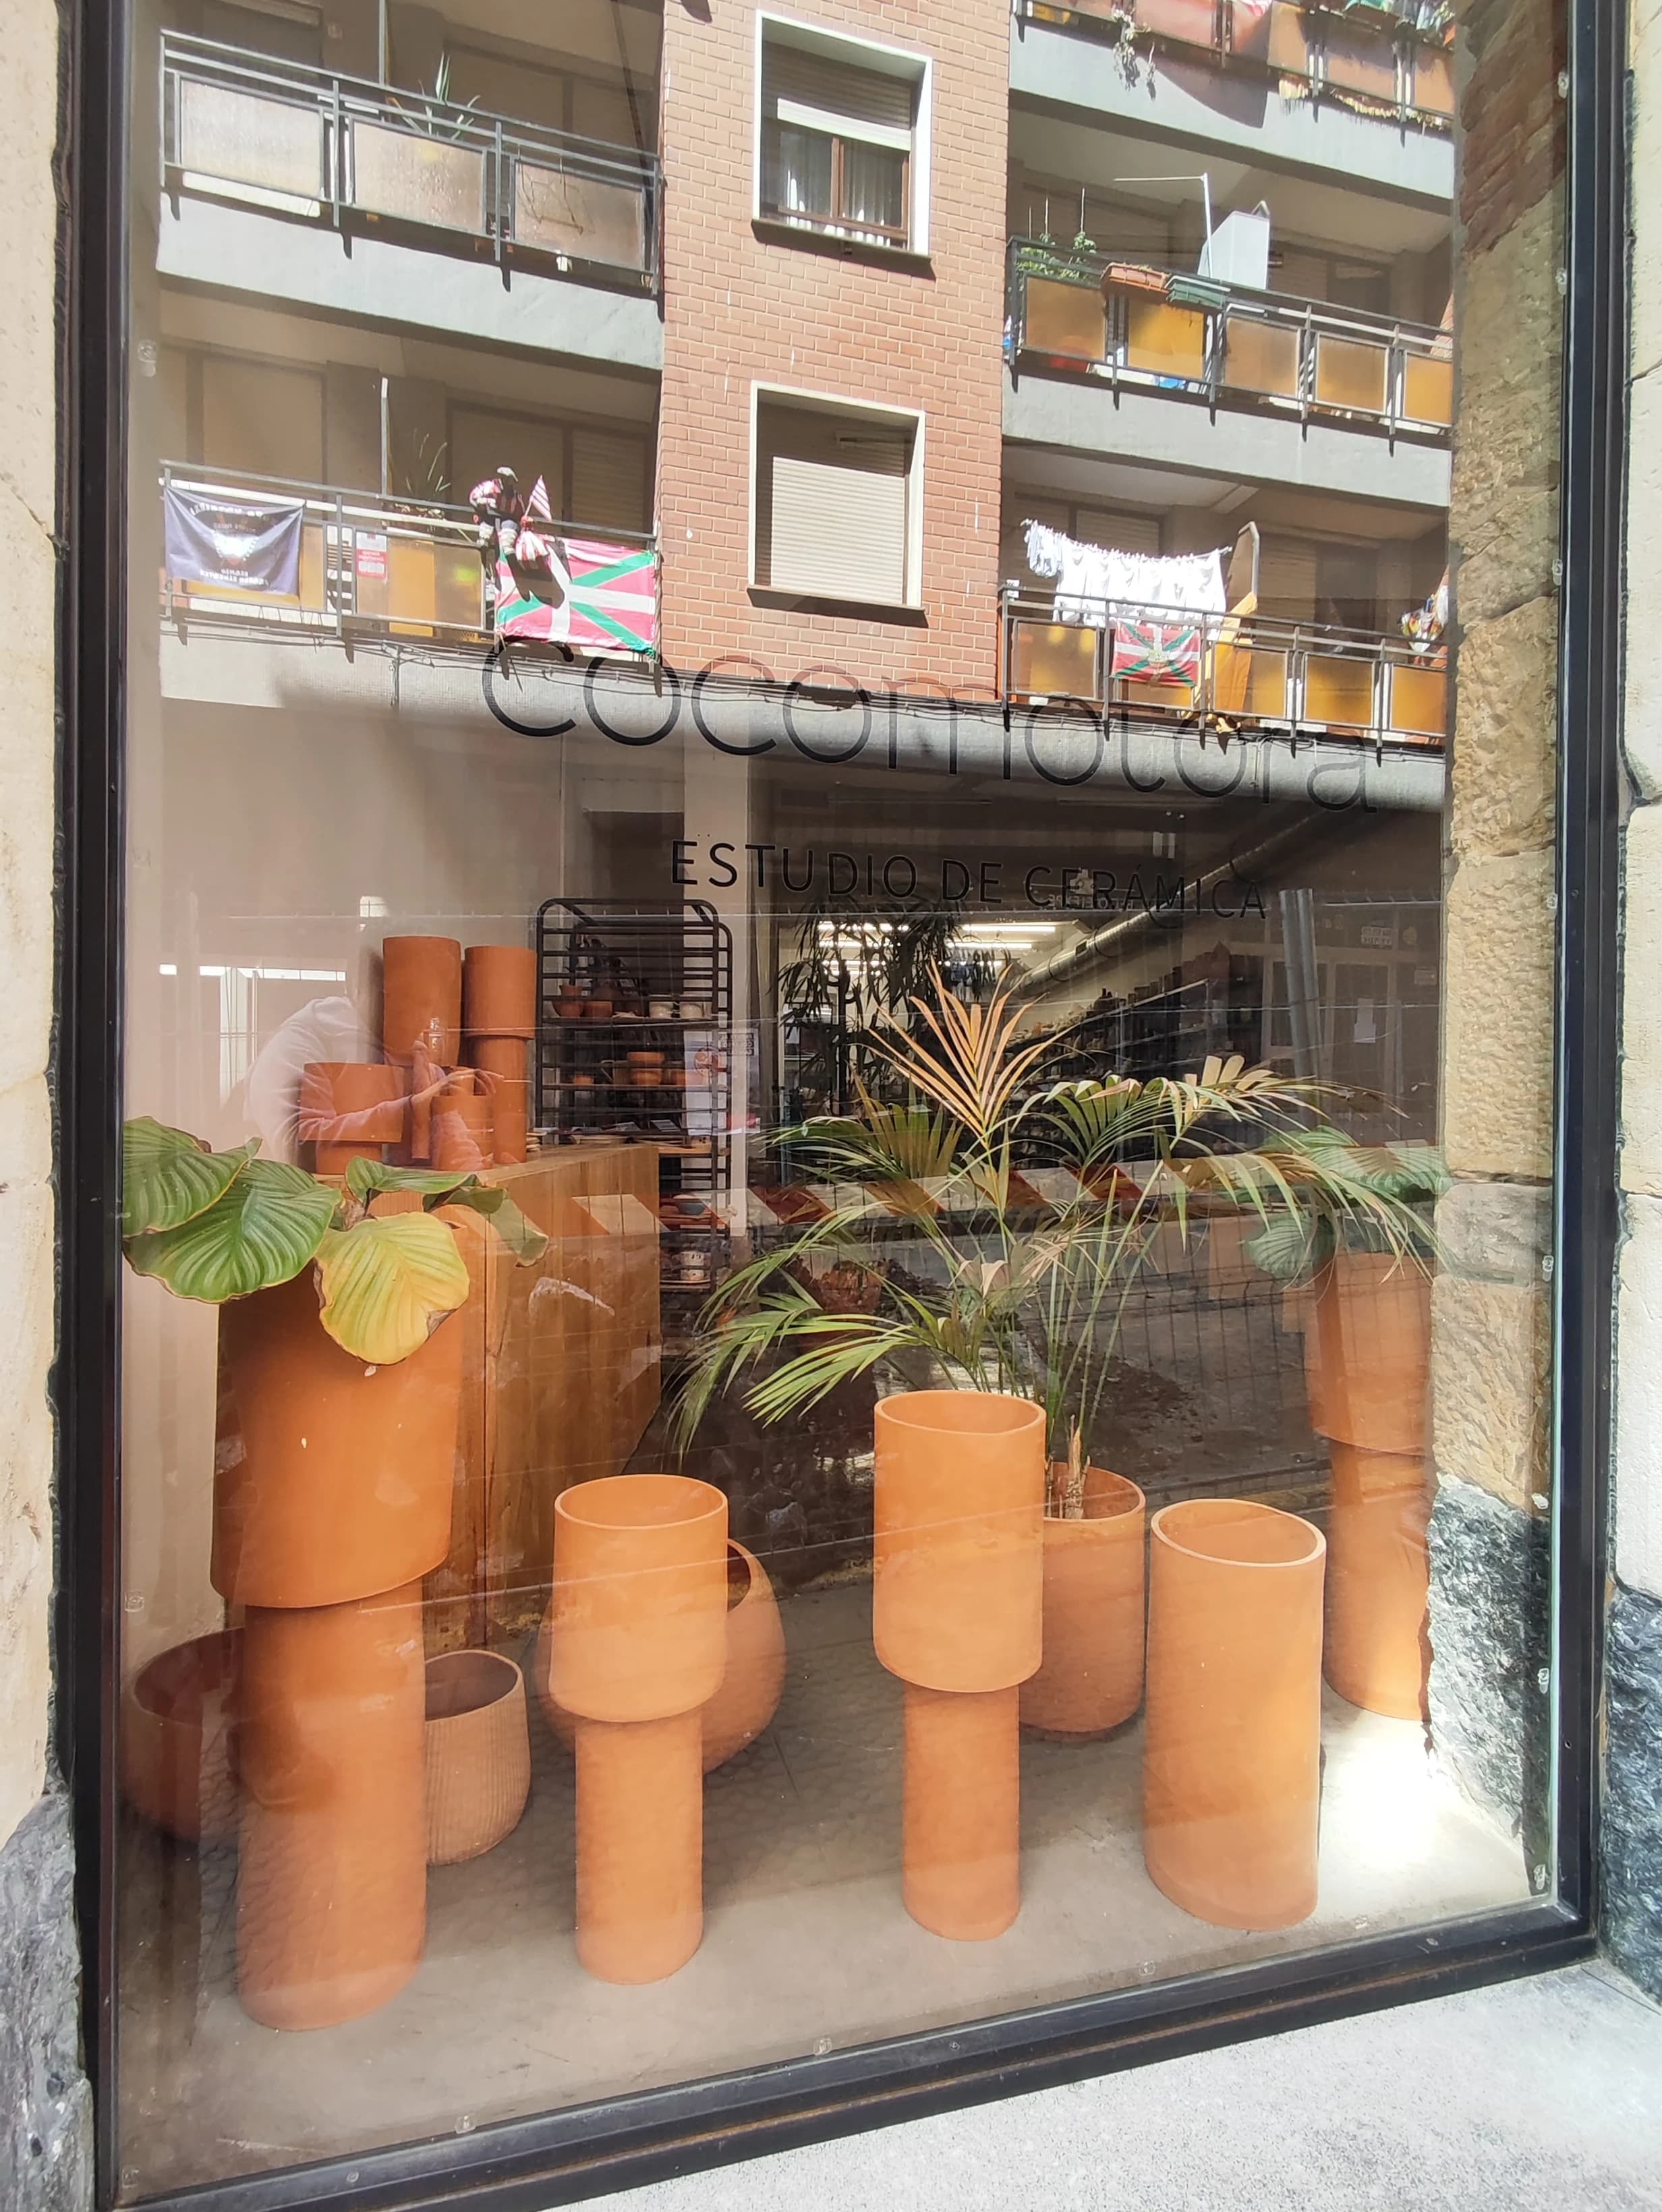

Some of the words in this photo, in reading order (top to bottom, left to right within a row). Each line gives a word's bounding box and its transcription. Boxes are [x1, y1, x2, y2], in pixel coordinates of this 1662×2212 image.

[482, 637, 1377, 813] cocomotora
[672, 840, 917, 899] ESTUDIO
[942, 859, 1003, 904] DE
[1024, 864, 1267, 921] CERÁMICA
